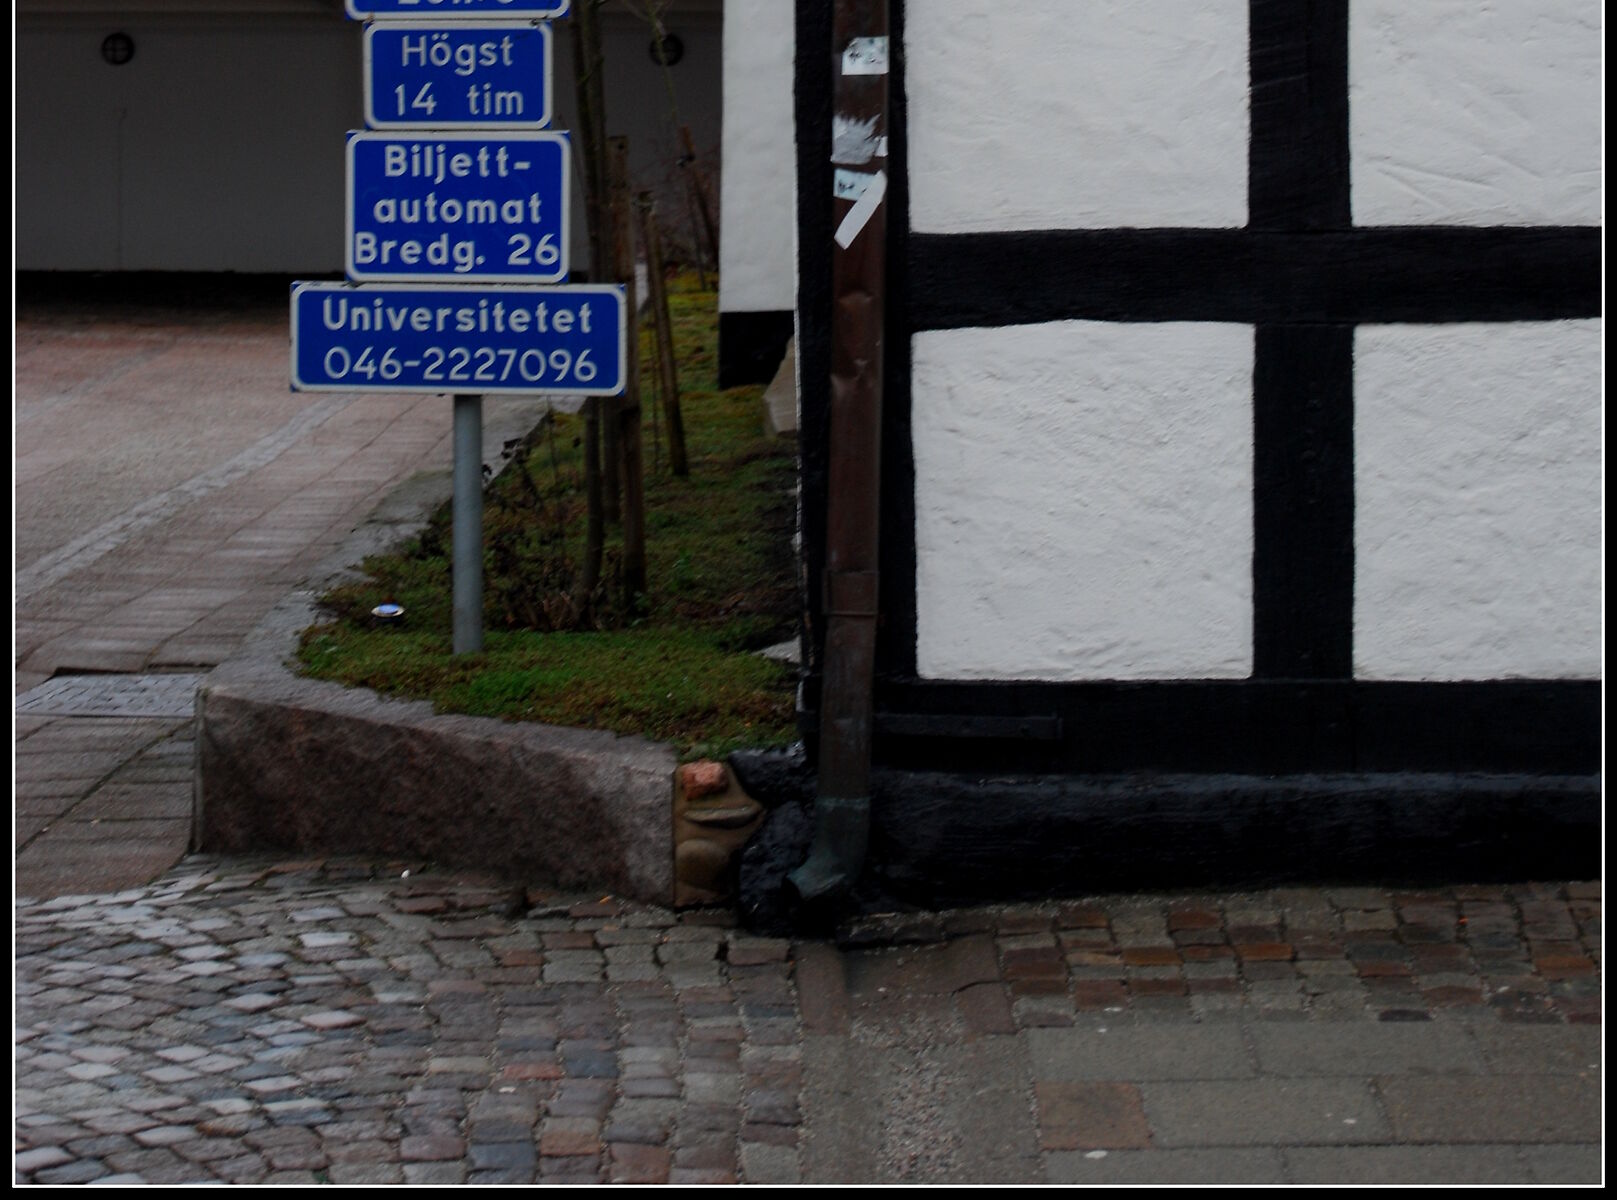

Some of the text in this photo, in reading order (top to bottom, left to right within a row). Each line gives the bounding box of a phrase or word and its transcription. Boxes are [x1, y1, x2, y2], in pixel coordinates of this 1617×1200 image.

[402, 33, 514, 76] Högst
[395, 82, 524, 116] 14 tim
[384, 143, 531, 184] Biljett-
[373, 192, 542, 224] automat
[354, 231, 560, 273] Bredg. 26
[322, 295, 592, 333] Universitetet
[323, 346, 598, 382] 046-2227096
